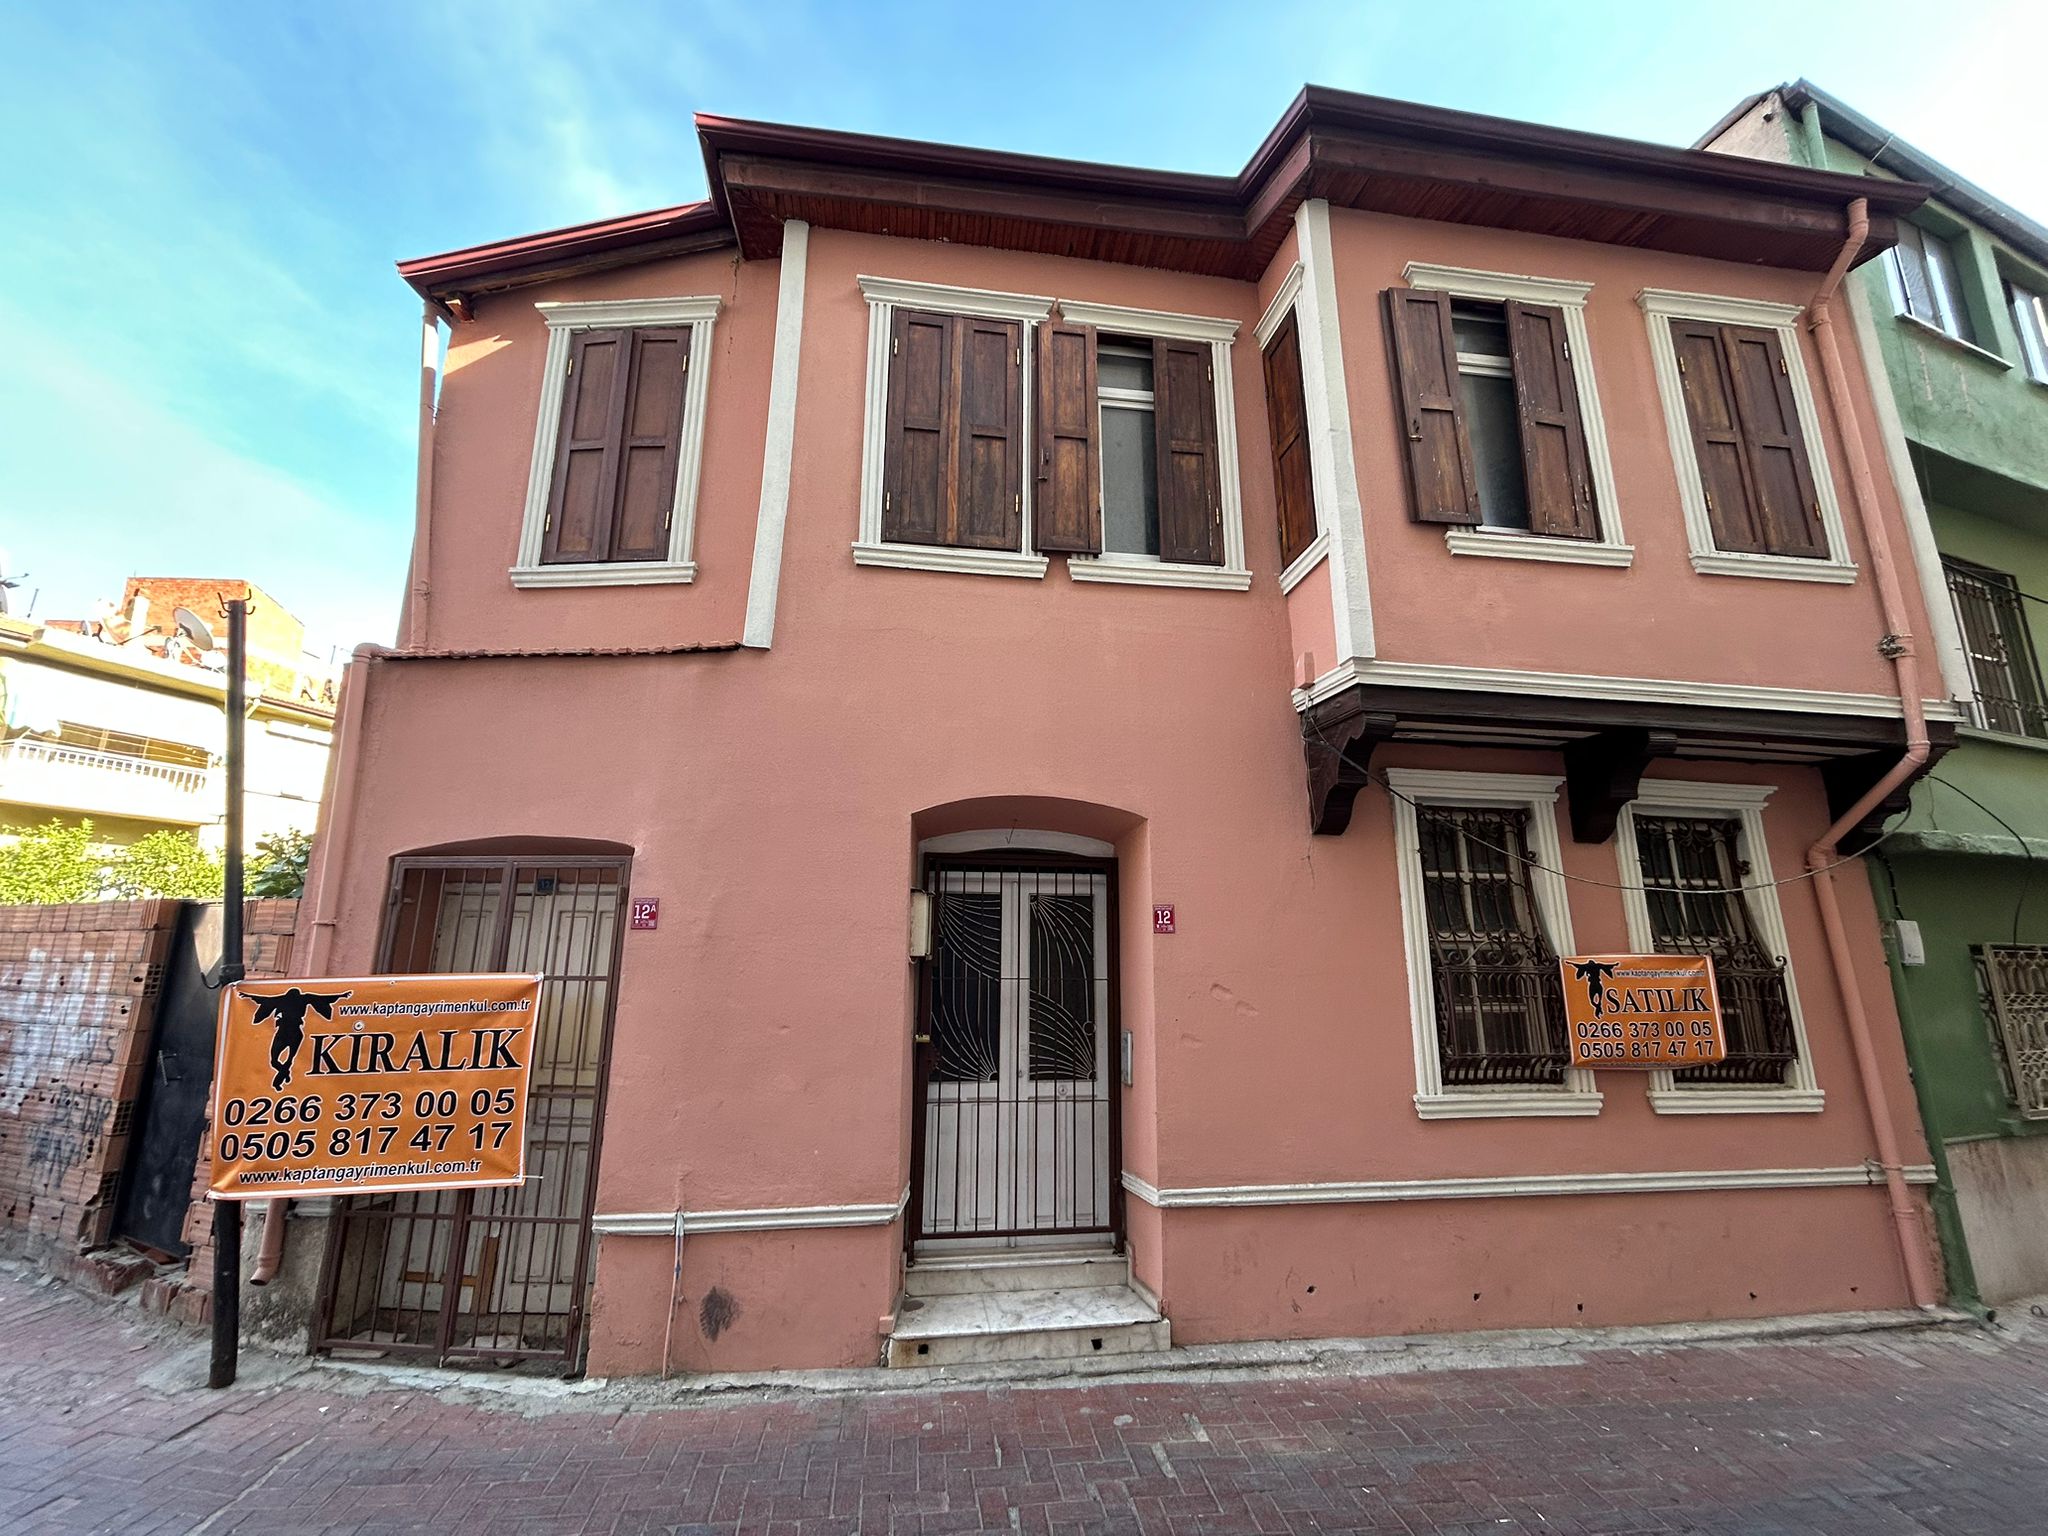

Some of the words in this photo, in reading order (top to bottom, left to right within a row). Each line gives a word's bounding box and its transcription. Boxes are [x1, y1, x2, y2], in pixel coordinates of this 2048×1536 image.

[1157, 910, 1171, 924] 12
[339, 999, 531, 1018] www.kaptangayrimenkul.com.tr
[1606, 988, 1711, 1013] SATILIK
[1577, 1022, 1623, 1038] 0266
[1629, 1022, 1660, 1038] 373
[1665, 1021, 1685, 1036] 00
[1691, 1021, 1712, 1036] 05
[306, 1028, 523, 1076] KIRALIK
[1580, 1042, 1625, 1058] 0505
[1631, 1042, 1661, 1058] 817
[1668, 1041, 1687, 1056] 47
[1695, 1040, 1714, 1056] 17
[224, 1095, 322, 1126] 0266
[334, 1092, 402, 1121] 373
[415, 1090, 457, 1117] 00
[470, 1088, 515, 1116] 05
[220, 1130, 316, 1161] 0505
[328, 1126, 398, 1156] 817
[410, 1124, 455, 1151] 47
[468, 1122, 513, 1149] 17
[239, 1160, 481, 1184] www.kaptangayrimenkul.com.tr
